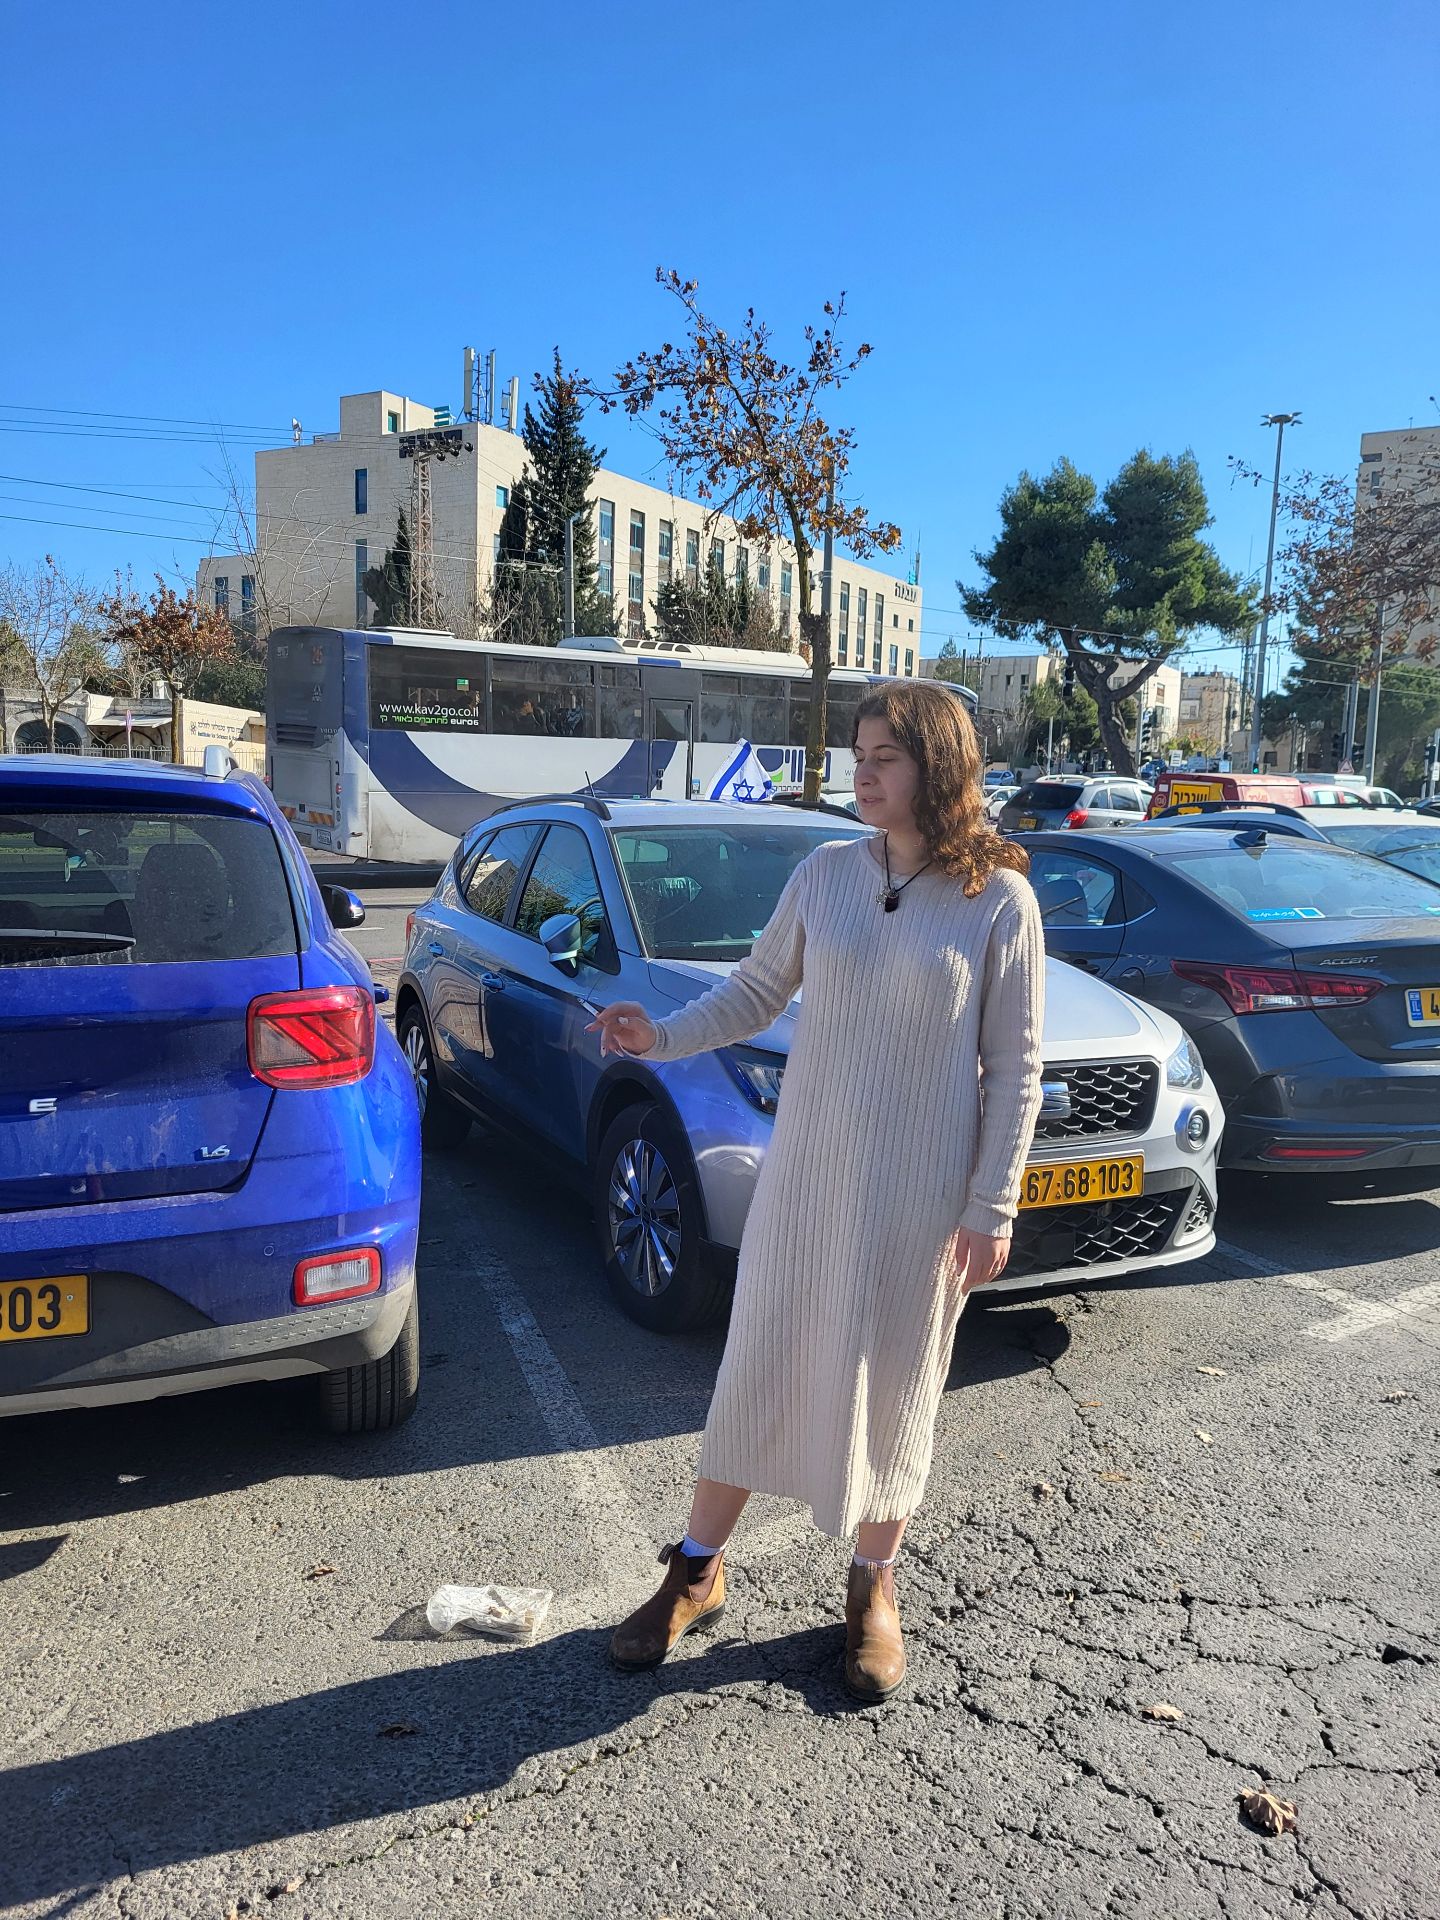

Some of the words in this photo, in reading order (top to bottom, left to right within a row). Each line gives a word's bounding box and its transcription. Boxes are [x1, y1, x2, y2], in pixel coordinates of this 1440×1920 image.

[380, 703, 479, 717] www.kav2go.co.il
[413, 716, 448, 725] מתחברים
[1319, 955, 1379, 966] ACCENT
[29, 1097, 58, 1113] E
[200, 1144, 231, 1159] 1.6
[0, 1283, 62, 1334] 03
